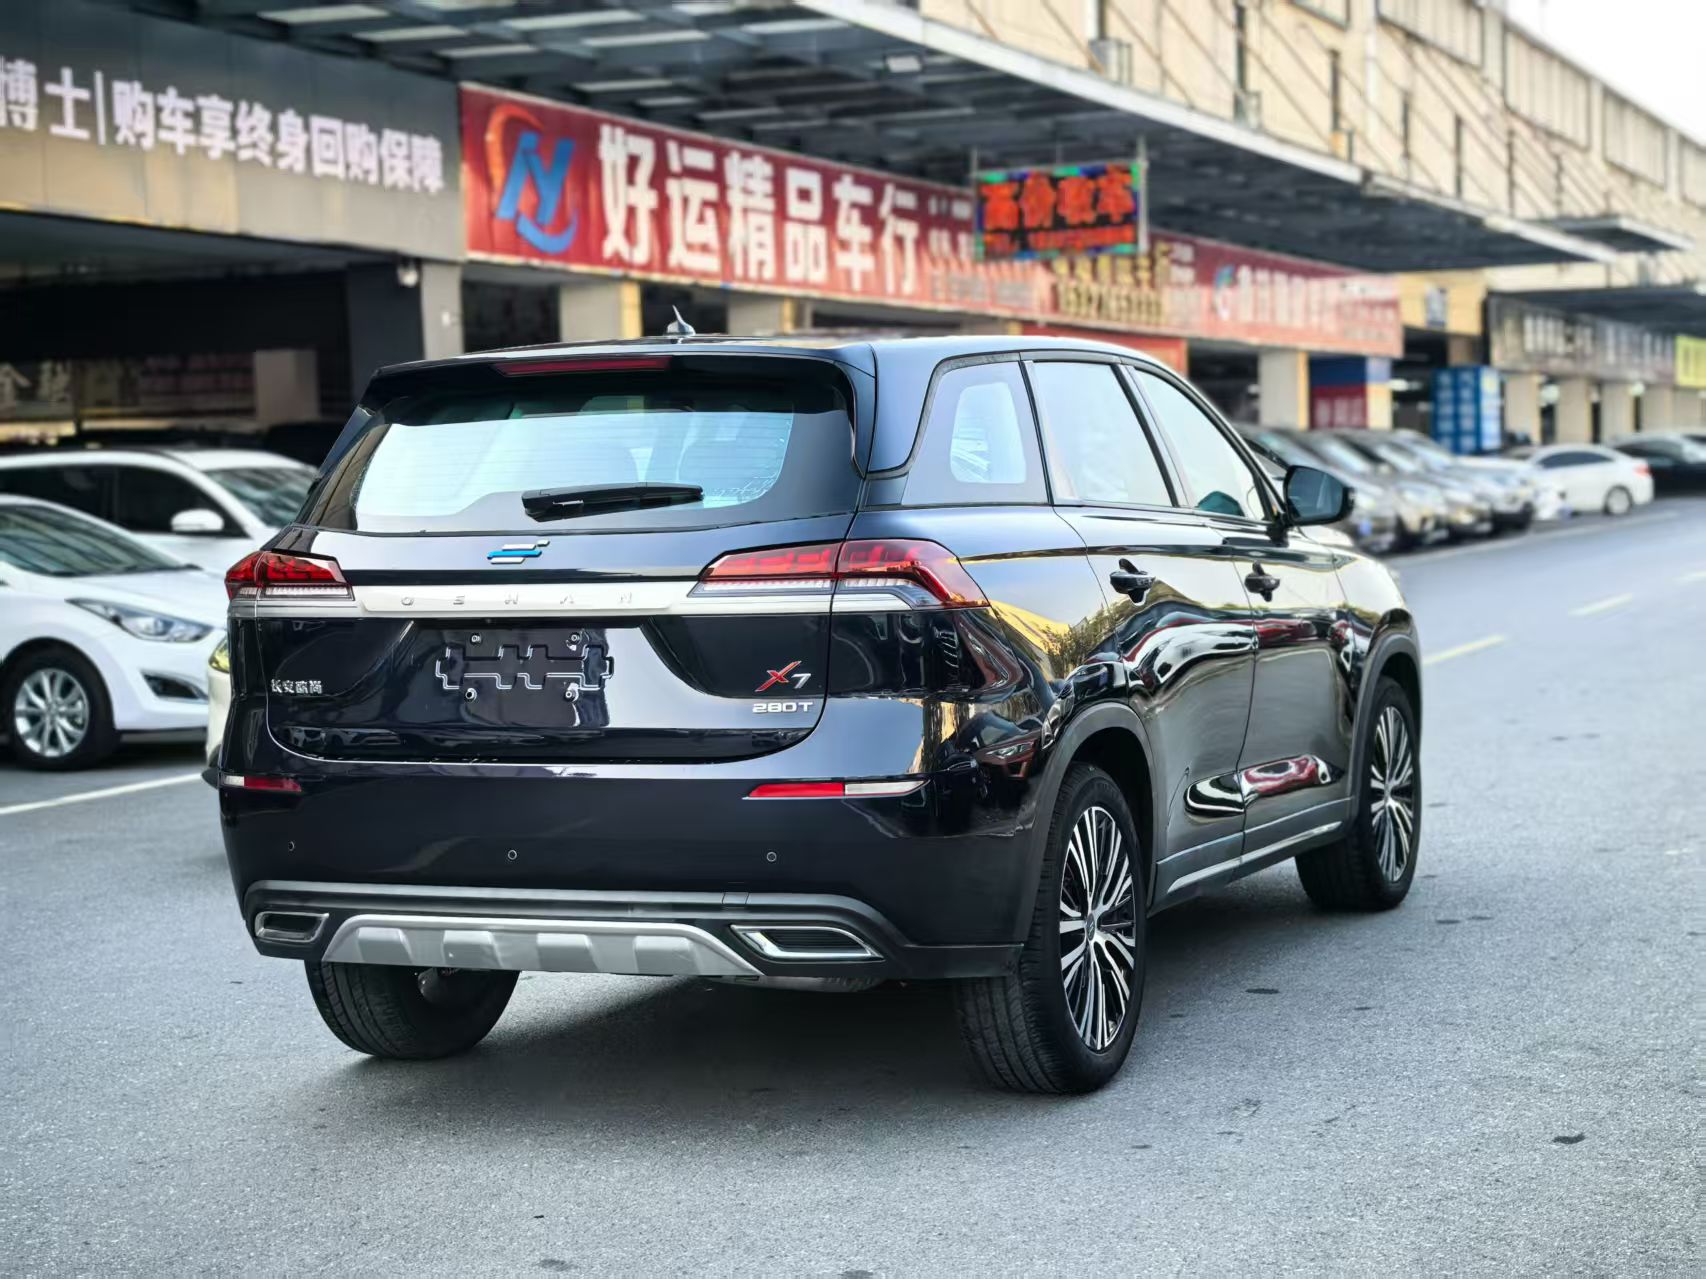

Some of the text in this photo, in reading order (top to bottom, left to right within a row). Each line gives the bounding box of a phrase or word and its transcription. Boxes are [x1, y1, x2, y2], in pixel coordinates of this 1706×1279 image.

[111, 79, 444, 194] 购车享终身回购保障
[599, 124, 919, 295] 好运精品车行
[271, 679, 322, 694] 长安欧尚
[754, 660, 811, 692] X7
[752, 702, 813, 713] 280T
